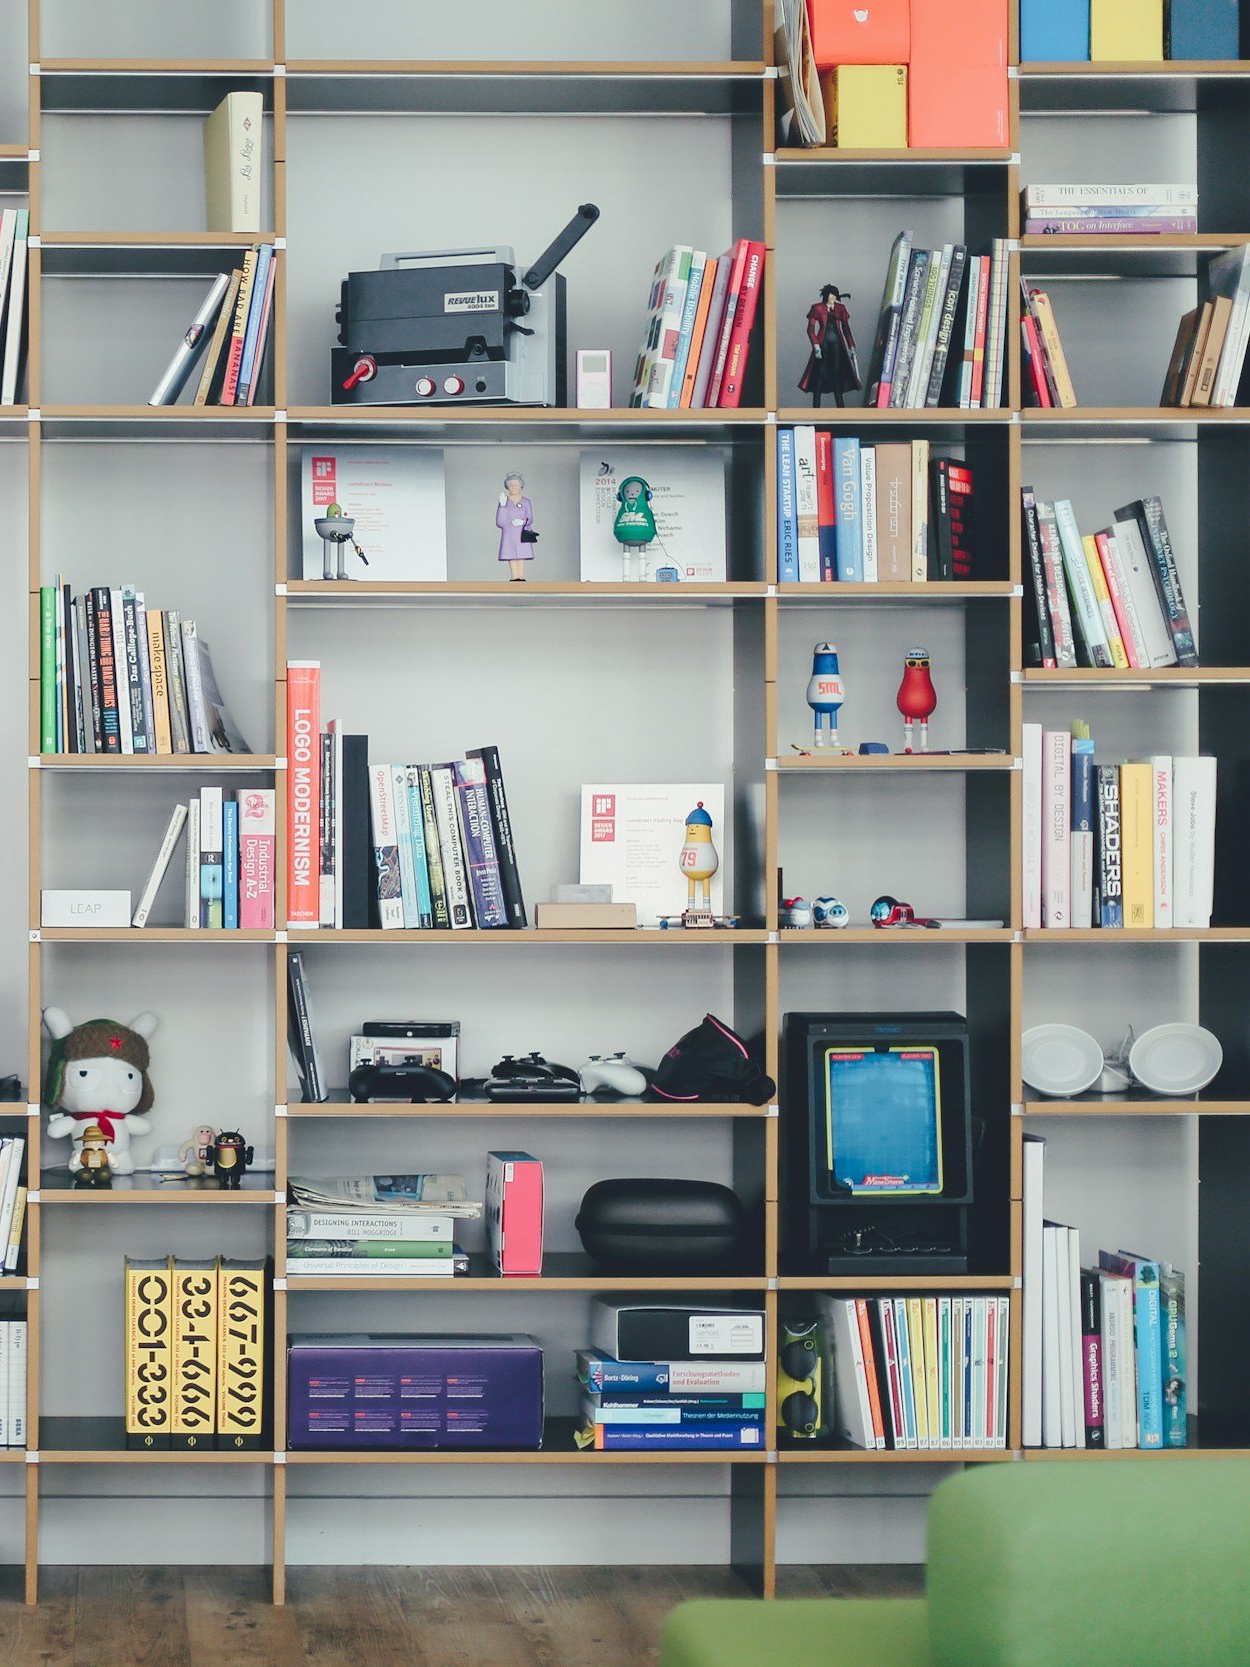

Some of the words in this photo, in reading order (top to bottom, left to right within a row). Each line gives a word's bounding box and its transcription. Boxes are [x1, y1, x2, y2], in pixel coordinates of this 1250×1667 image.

[1058, 187, 1076, 195] THE
[1080, 187, 1134, 195] ESSENTIALS
[1136, 187, 1150, 195] OF
[241, 259, 251, 284] HOW
[688, 272, 701, 300] Mobile
[747, 254, 759, 289] CHANGE
[237, 290, 247, 310] BAD
[906, 266, 924, 324] Scenario-Focused
[947, 290, 959, 311] icon
[233, 314, 243, 334] ARE
[680, 300, 696, 336] Usability
[937, 313, 955, 344] design
[899, 324, 915, 364] Engineering
[227, 339, 243, 397] BANANAS?
[781, 434, 791, 455] THE
[781, 456, 791, 477] LEAN
[798, 457, 816, 479] art
[841, 449, 856, 476] Van
[781, 478, 791, 518] STARTUP
[840, 480, 857, 521] Gogh
[865, 483, 874, 529] Proposition
[783, 520, 791, 541] ERIC
[866, 531, 875, 563] Design
[783, 542, 792, 563] RIES
[1161, 566, 1179, 619] PSYCHOLOGY
[125, 605, 138, 664] Calliope-Buch
[152, 632, 166, 663] make
[130, 664, 139, 683] Das
[150, 664, 164, 697] space
[818, 681, 842, 695] SML
[294, 708, 311, 763] LOGO
[1054, 735, 1065, 778] DIGITAL
[377, 770, 390, 837] OpenStreetMap
[1054, 784, 1064, 797] BY
[1157, 770, 1168, 826] MAKERS
[294, 767, 311, 886] MODERNISM
[411, 791, 421, 837] Visualizing
[416, 839, 424, 859] Data
[465, 789, 480, 838] INTERACTION
[475, 788, 494, 860] HUMAN-COMPUTER
[1054, 803, 1064, 841] DESIGN
[1104, 783, 1121, 897] SHADERS
[243, 839, 257, 877] Design
[258, 839, 270, 894] Industrial
[246, 877, 258, 899] A-Z
[70, 904, 102, 913] LEAP
[13, 1146, 21, 1159] Wii
[313, 1219, 350, 1227] DESIGNING
[351, 1219, 398, 1228] INTERACTIONS
[347, 1229, 361, 1237] BILL
[361, 1229, 398, 1237] MOGGRIDGE
[304, 1261, 333, 1270] Universal
[337, 1261, 370, 1271] Principles
[372, 1261, 379, 1270] of
[381, 1261, 403, 1271] Design
[138, 1276, 168, 1427] 001-333
[181, 1276, 212, 1427] 334-666
[228, 1276, 258, 1427] 667-999
[1088, 1342, 1100, 1382] Graphics
[672, 1370, 741, 1379] Forschungsmethoden
[603, 1401, 640, 1409] Kohlhammer
[682, 1411, 706, 1419] Theorien
[706, 1411, 717, 1419] der
[717, 1411, 759, 1421] Mediennutzung
[1090, 1382, 1100, 1419] Shaders
